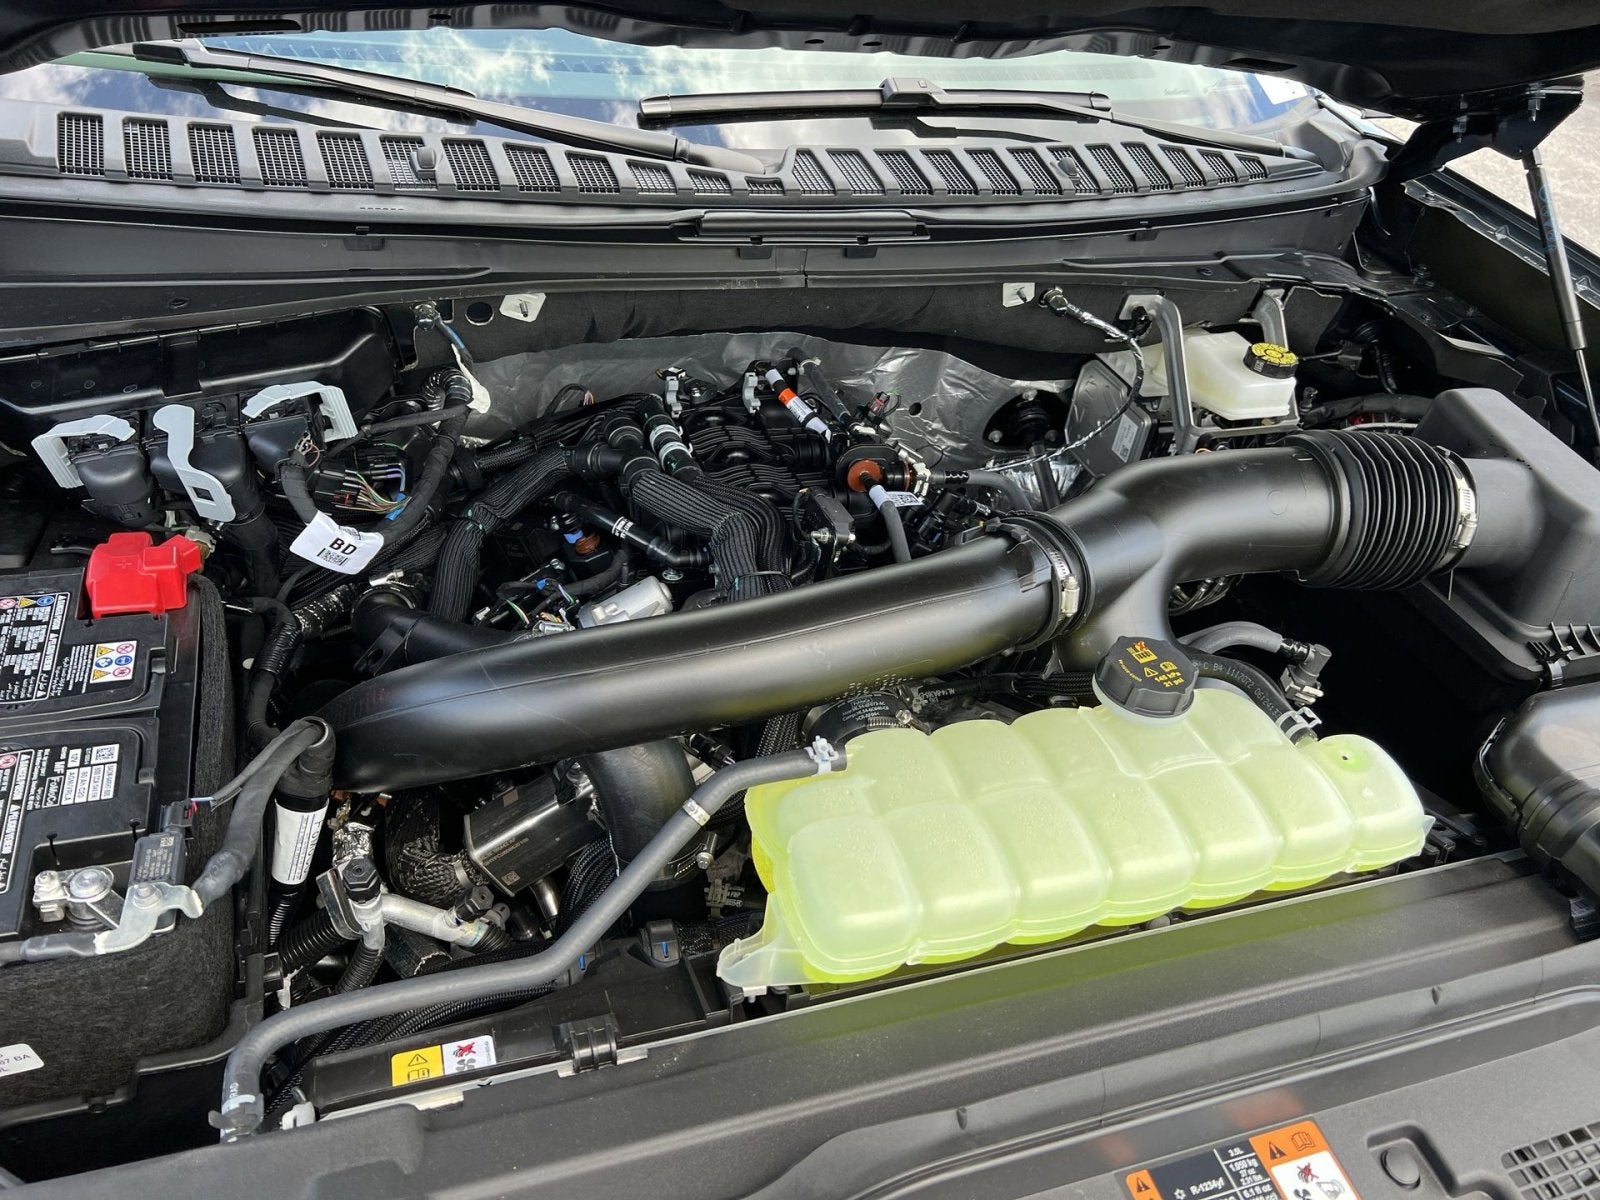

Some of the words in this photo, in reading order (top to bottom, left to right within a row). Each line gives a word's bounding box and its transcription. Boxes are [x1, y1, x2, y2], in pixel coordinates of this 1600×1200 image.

[329, 537, 357, 555] BD
[70, 752, 79, 763] 12V
[54, 761, 66, 774] MF
[46, 777, 60, 806] FoMoCo
[1246, 1158, 1258, 1168] kg
[1190, 1176, 1224, 1195] R-1234yf
[1262, 1184, 1273, 1192] oz
